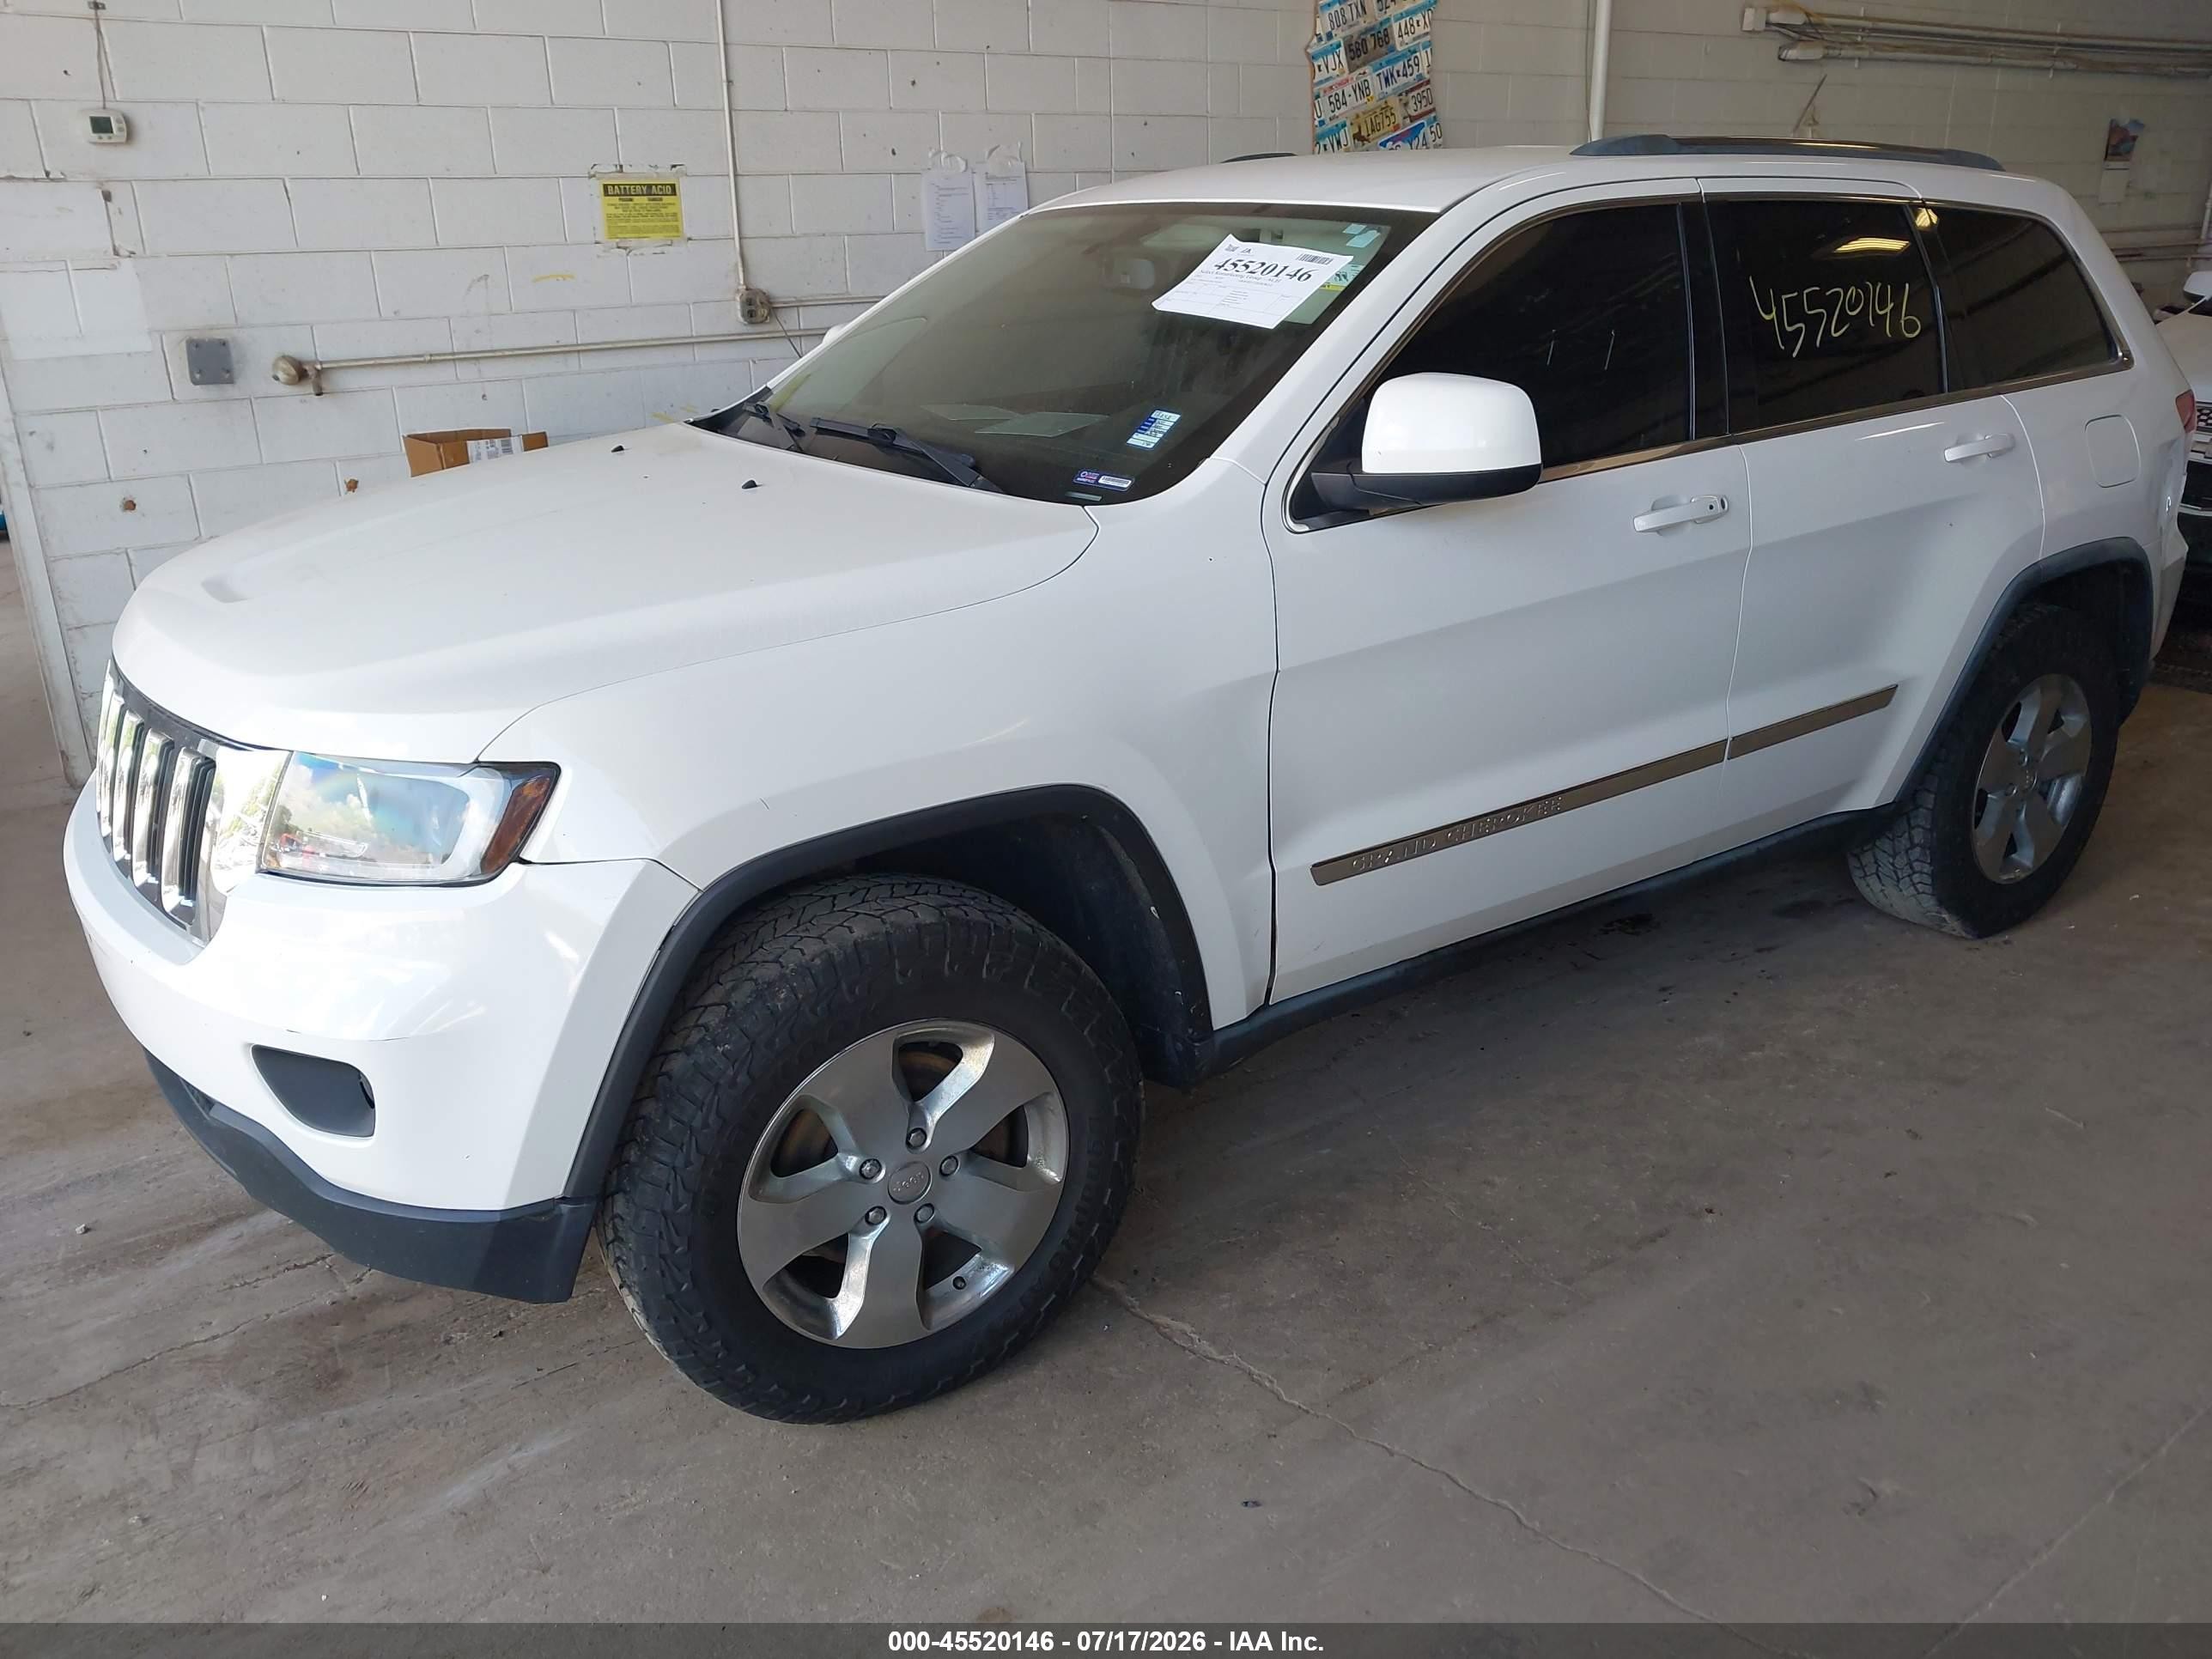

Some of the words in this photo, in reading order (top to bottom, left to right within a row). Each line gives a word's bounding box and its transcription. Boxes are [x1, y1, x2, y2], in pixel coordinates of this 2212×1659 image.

[1411, 88, 1433, 112] 3950
[607, 185, 647, 195] BATTERY
[651, 185, 672, 195] ACID
[1213, 257, 1321, 283] 45520146
[1748, 275, 1923, 358] 45520146
